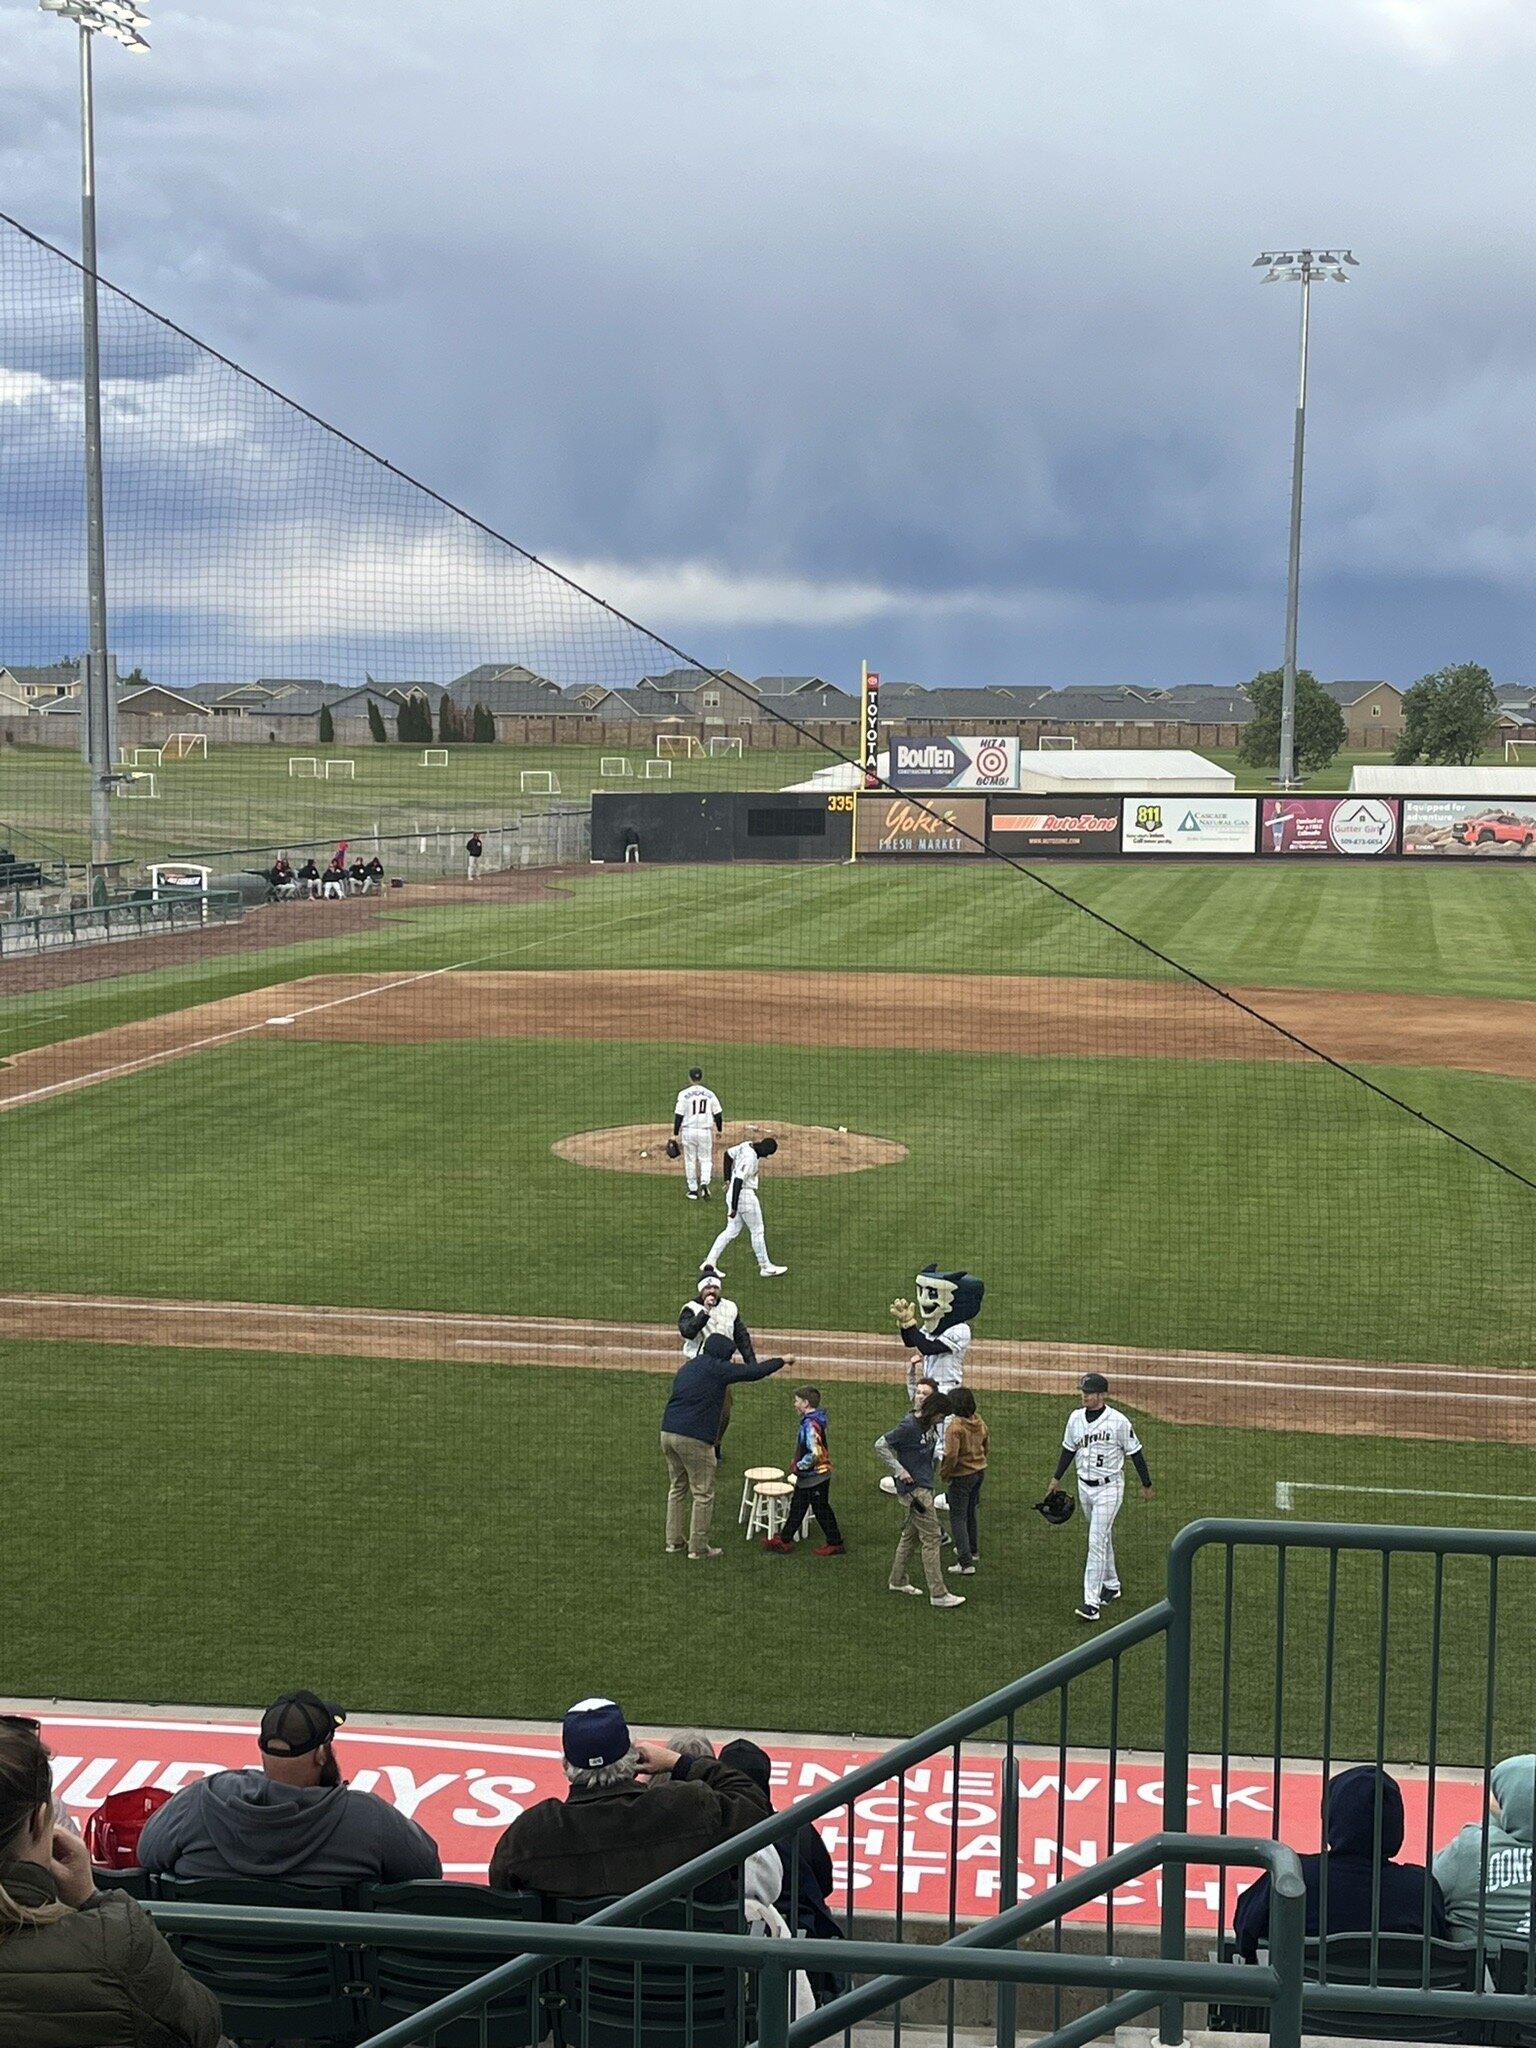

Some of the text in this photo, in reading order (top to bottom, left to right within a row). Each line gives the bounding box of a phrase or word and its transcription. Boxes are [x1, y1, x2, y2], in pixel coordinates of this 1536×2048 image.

[867, 691, 877, 766] TOYOTA
[980, 739, 1006, 748] HIT A
[976, 777, 1009, 786] BOMB!
[828, 796, 853, 812] 335
[1407, 803, 1466, 812] Equipped for
[1137, 806, 1160, 822] 811
[1042, 814, 1117, 832] AutoZone
[879, 838, 962, 850] FRESH MARKET
[692, 1099, 707, 1114] 10
[1096, 1454, 1104, 1467] 5
